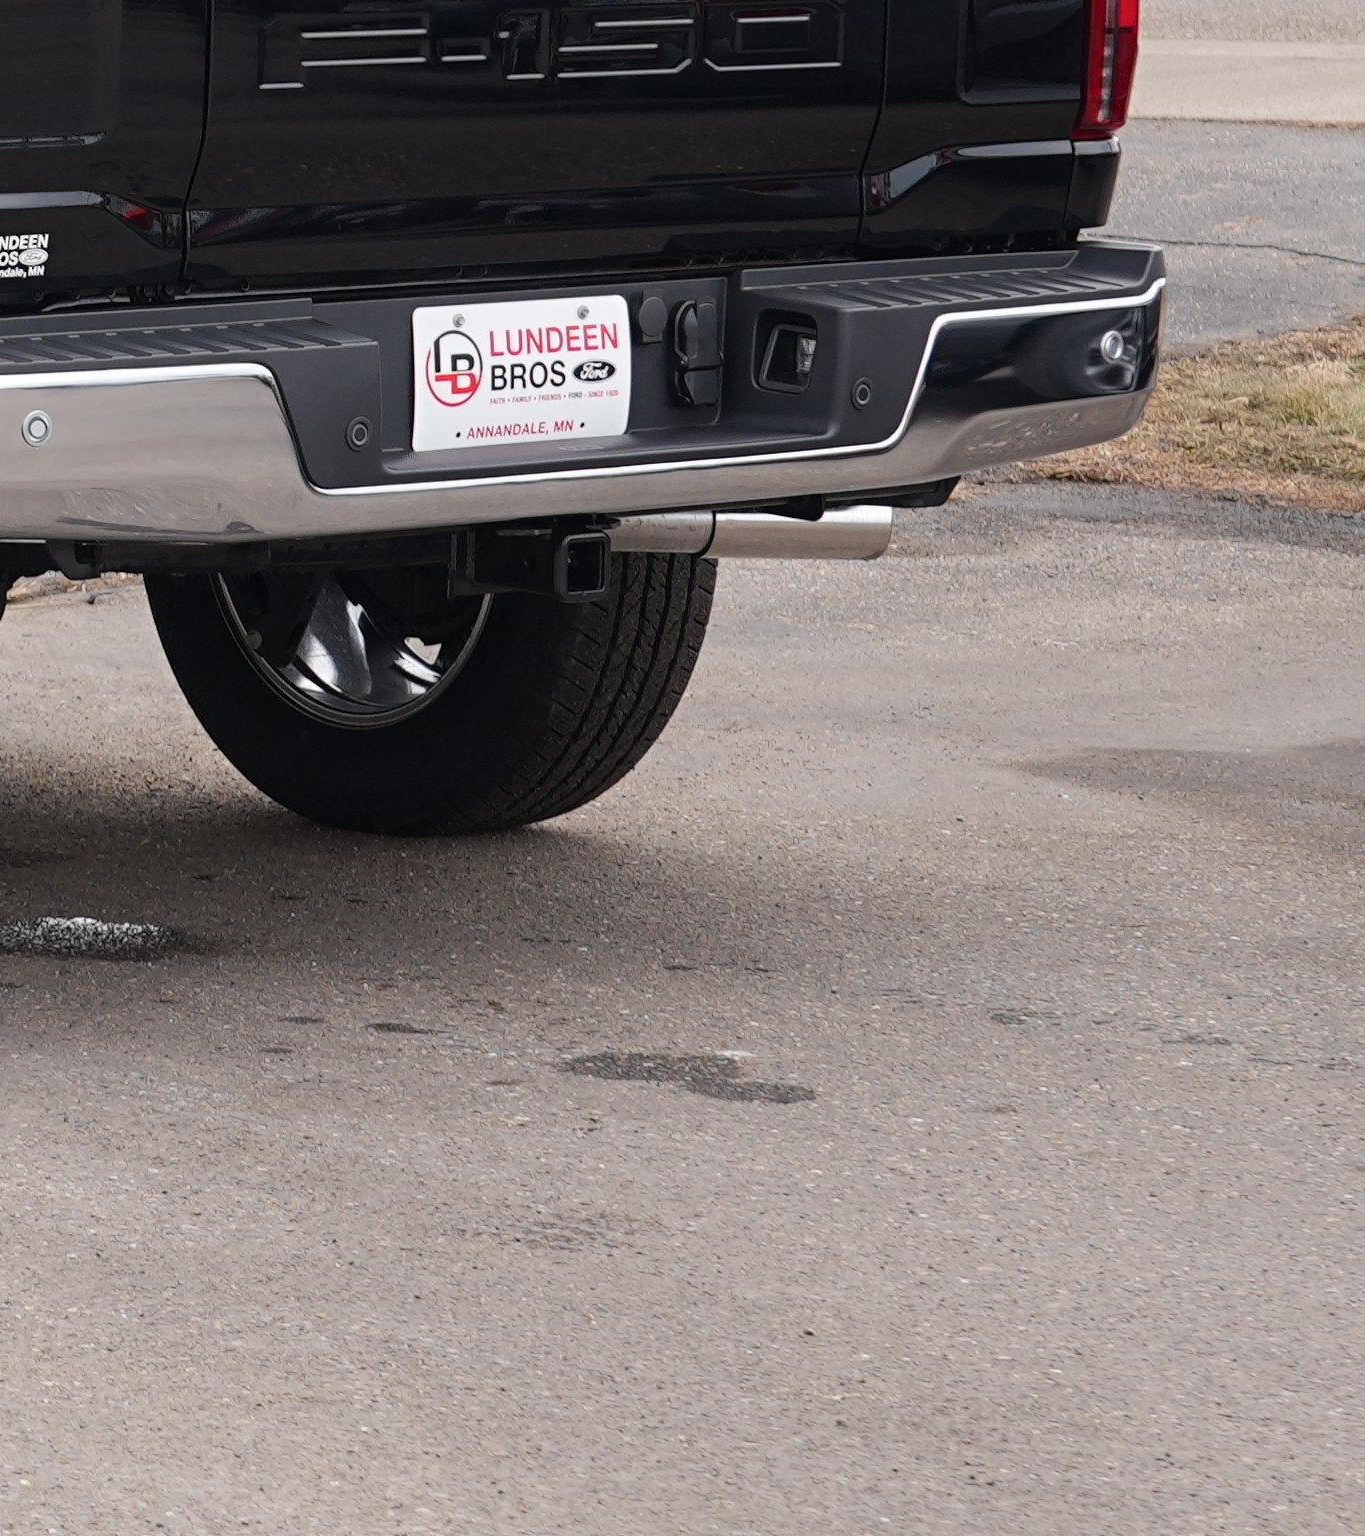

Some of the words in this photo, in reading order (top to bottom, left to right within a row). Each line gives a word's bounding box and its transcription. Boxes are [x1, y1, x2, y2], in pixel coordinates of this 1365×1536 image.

[258, 0, 844, 91] F-150
[28, 265, 45, 277] MN
[489, 323, 619, 357] LUNDEEN
[490, 360, 566, 391] BROS
[466, 421, 549, 440] ANNANDALE,
[553, 419, 574, 432] MN
